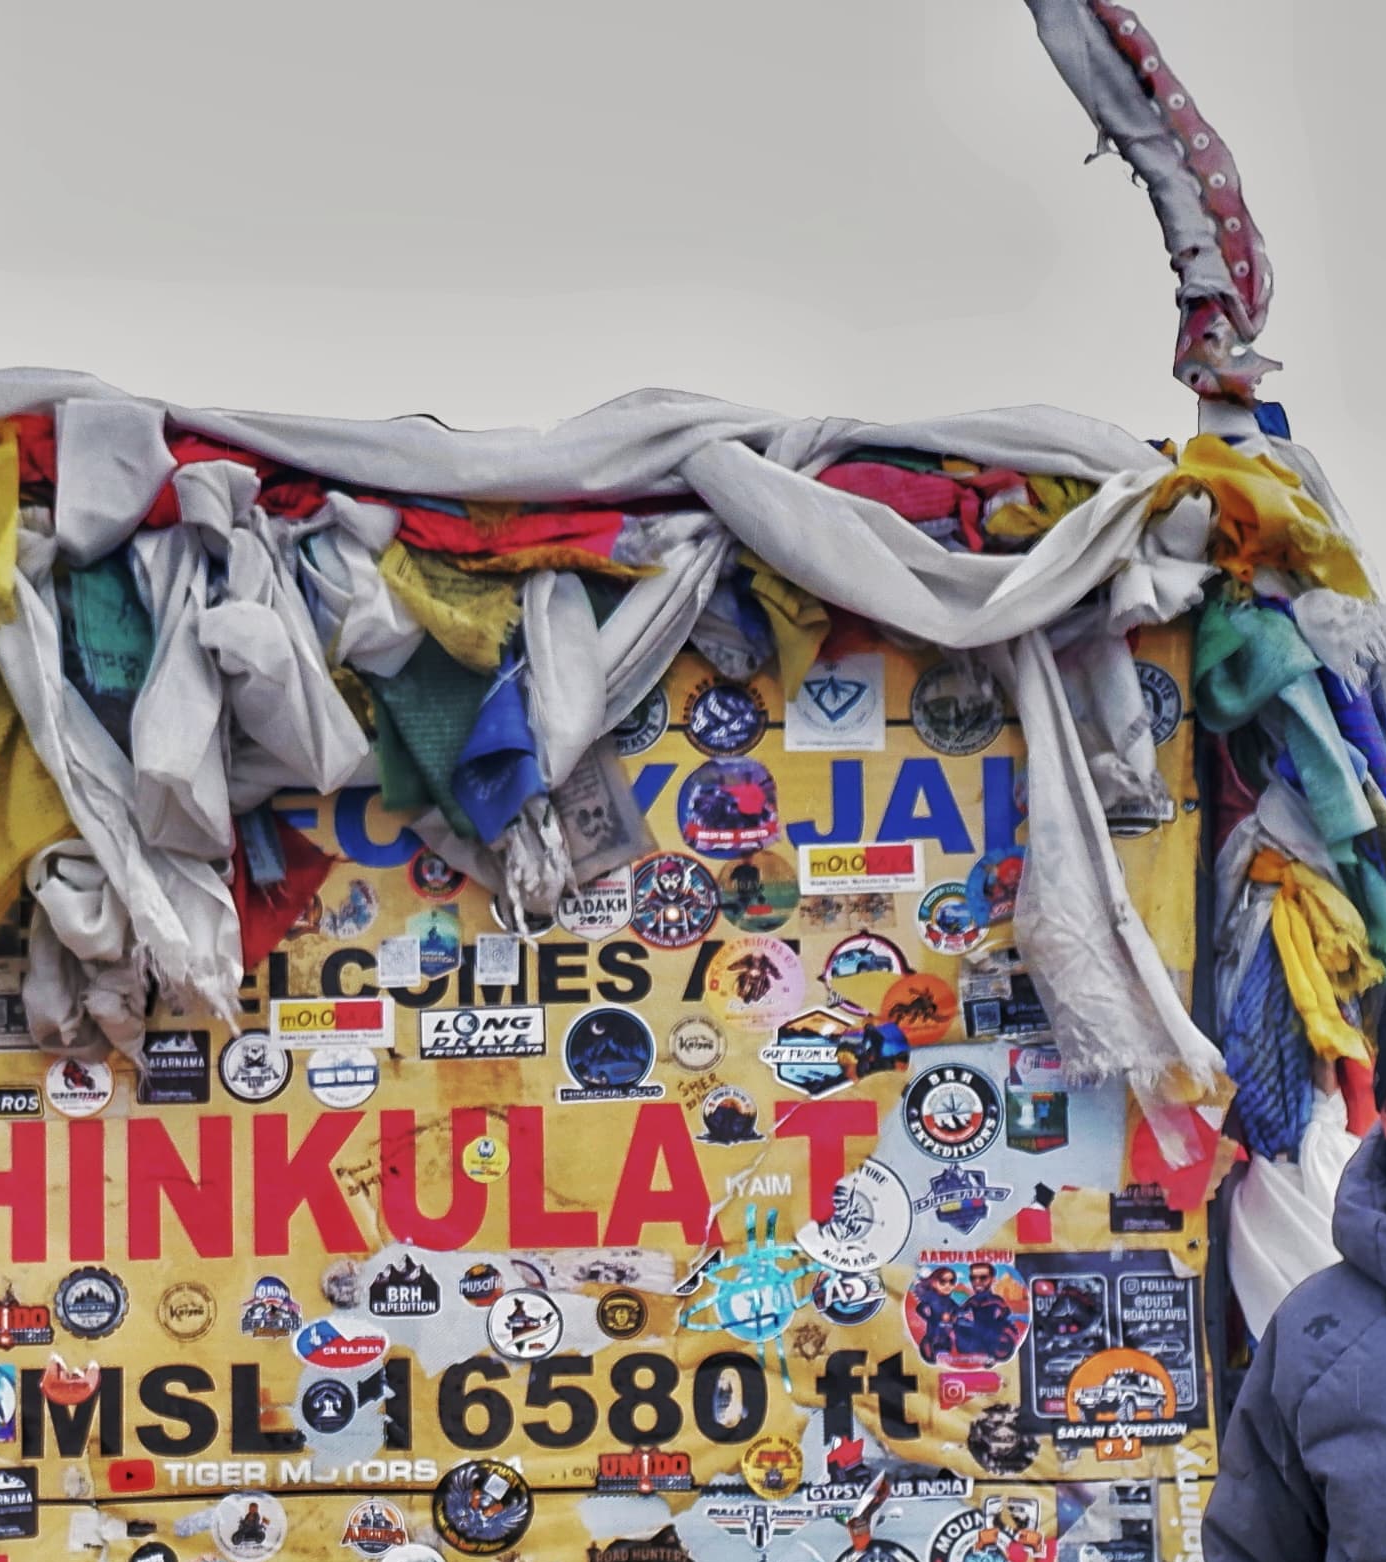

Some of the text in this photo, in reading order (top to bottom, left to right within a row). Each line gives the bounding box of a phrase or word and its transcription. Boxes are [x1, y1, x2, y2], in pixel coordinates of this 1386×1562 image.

[563, 898, 628, 915] LADAKH
[433, 1013, 533, 1036] LONG
[147, 1055, 206, 1069] AFARNAMA
[927, 1068, 974, 1087] BRH
[909, 1116, 997, 1159] EXPEDITIONS
[386, 1286, 422, 1304] BRH
[1141, 1280, 1185, 1293] FOLLOW
[373, 1301, 437, 1314] EXPEDITION
[1123, 1308, 1188, 1322] ROADTRAVEL
[19, 1349, 921, 1461] MSL 16580 ft
[1057, 1423, 1188, 1440] SAFARI EXPEDITION
[164, 1461, 267, 1486] TIGER
[600, 1453, 691, 1476] UNIDO
[809, 1483, 864, 1500] GYPSY
[917, 1478, 964, 1496] INDIA
